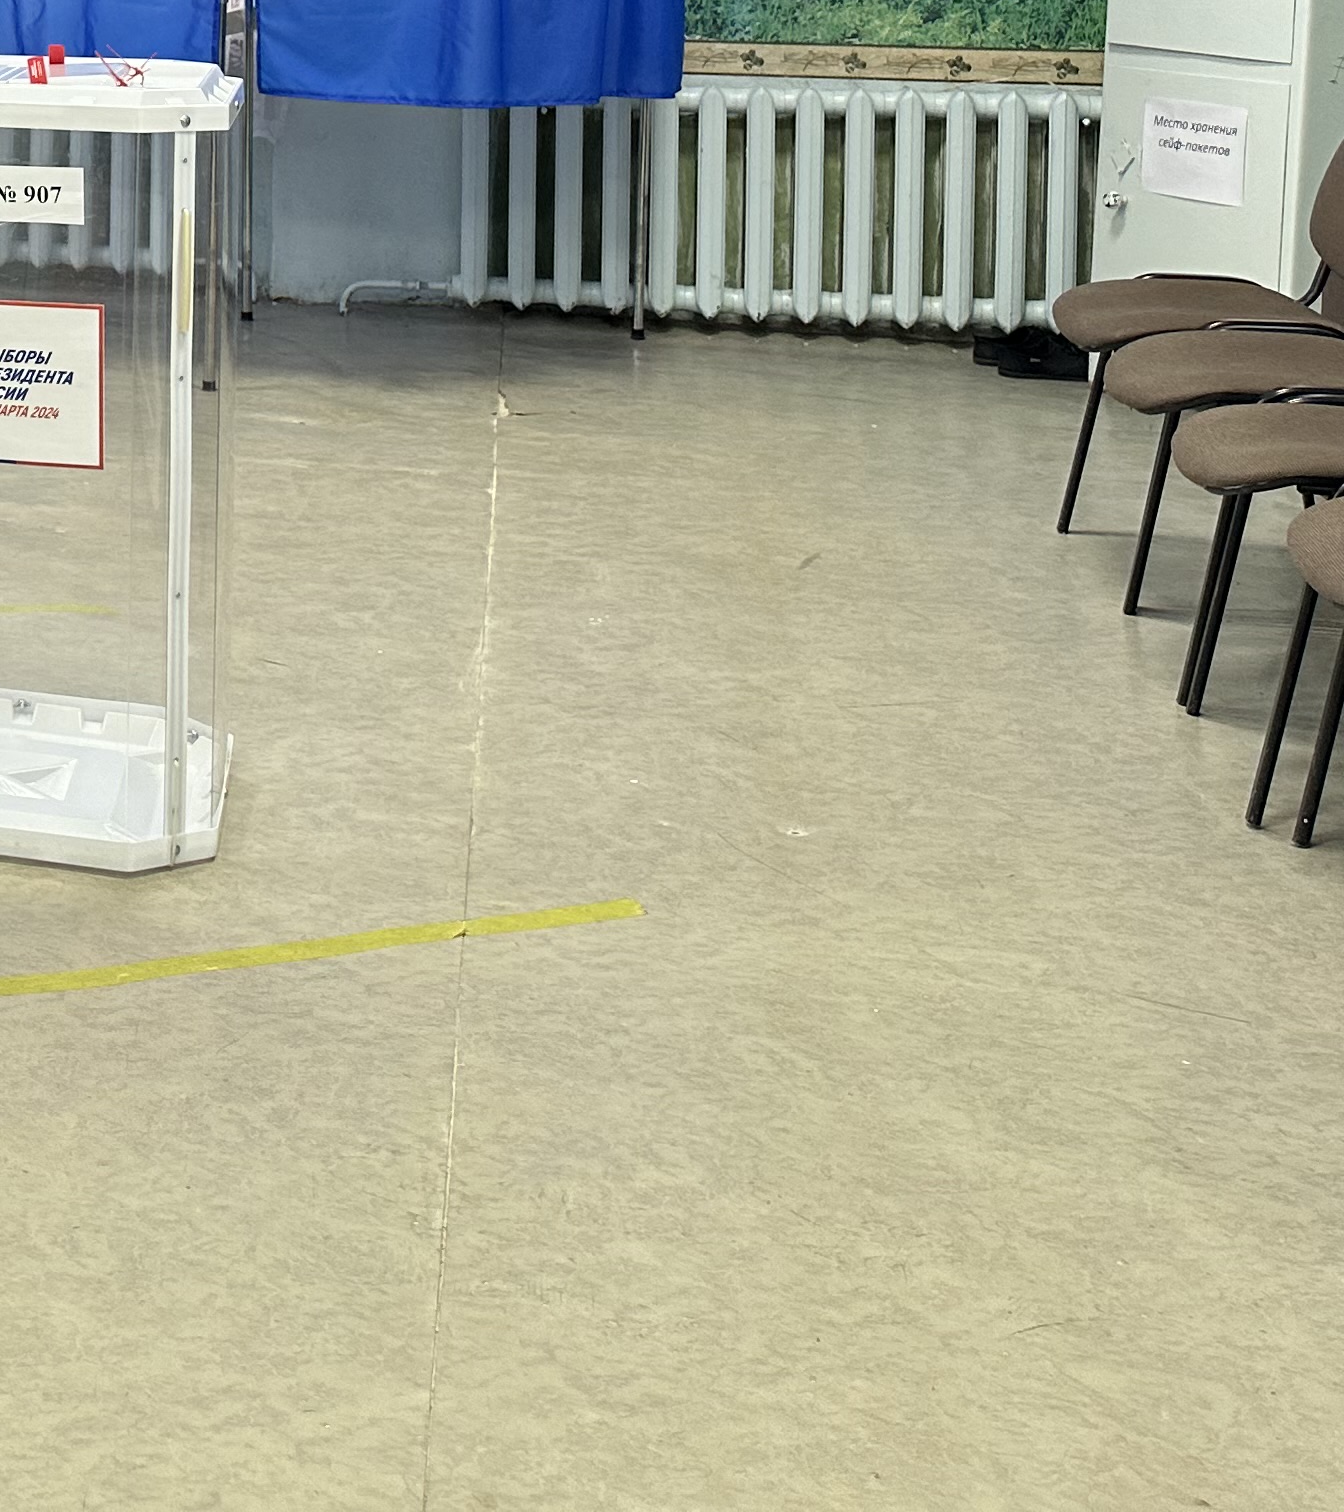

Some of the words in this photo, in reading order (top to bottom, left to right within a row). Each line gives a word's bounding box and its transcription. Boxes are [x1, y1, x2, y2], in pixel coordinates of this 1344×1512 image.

[1153, 115, 1188, 129] Место
[1190, 122, 1237, 136] хранения
[1158, 137, 1230, 156] сейф-пакетов
[24, 185, 62, 204] 907
[30, 406, 60, 419] 2024
